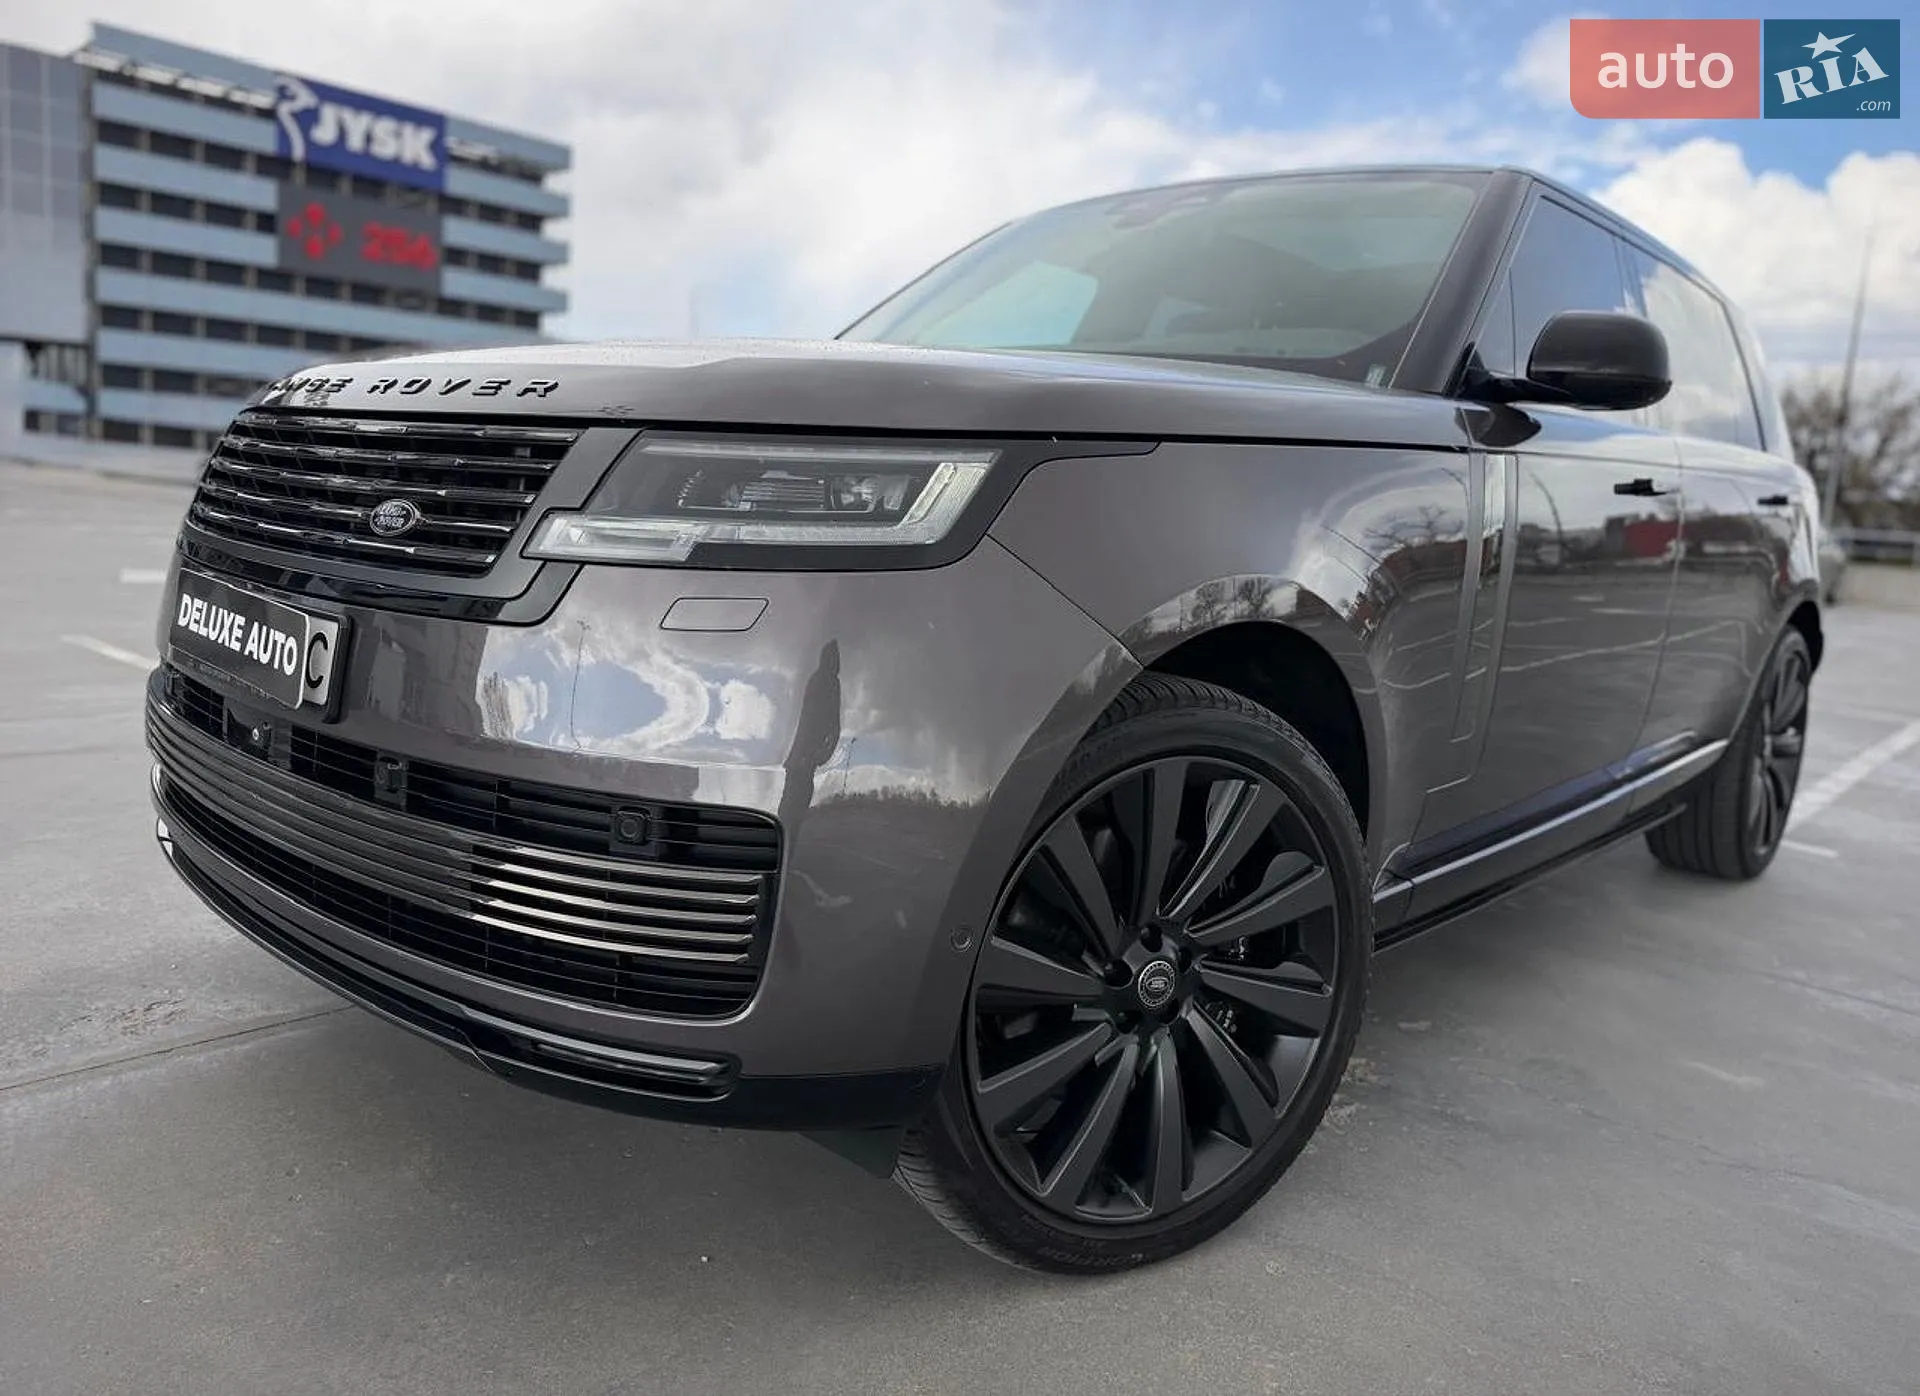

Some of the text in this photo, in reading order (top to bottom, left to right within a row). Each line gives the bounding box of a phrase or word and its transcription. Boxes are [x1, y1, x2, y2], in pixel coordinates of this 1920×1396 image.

[311, 103, 437, 171] JYSK
[367, 376, 560, 398] ROVER
[177, 594, 298, 676] DELUXE AUTO
